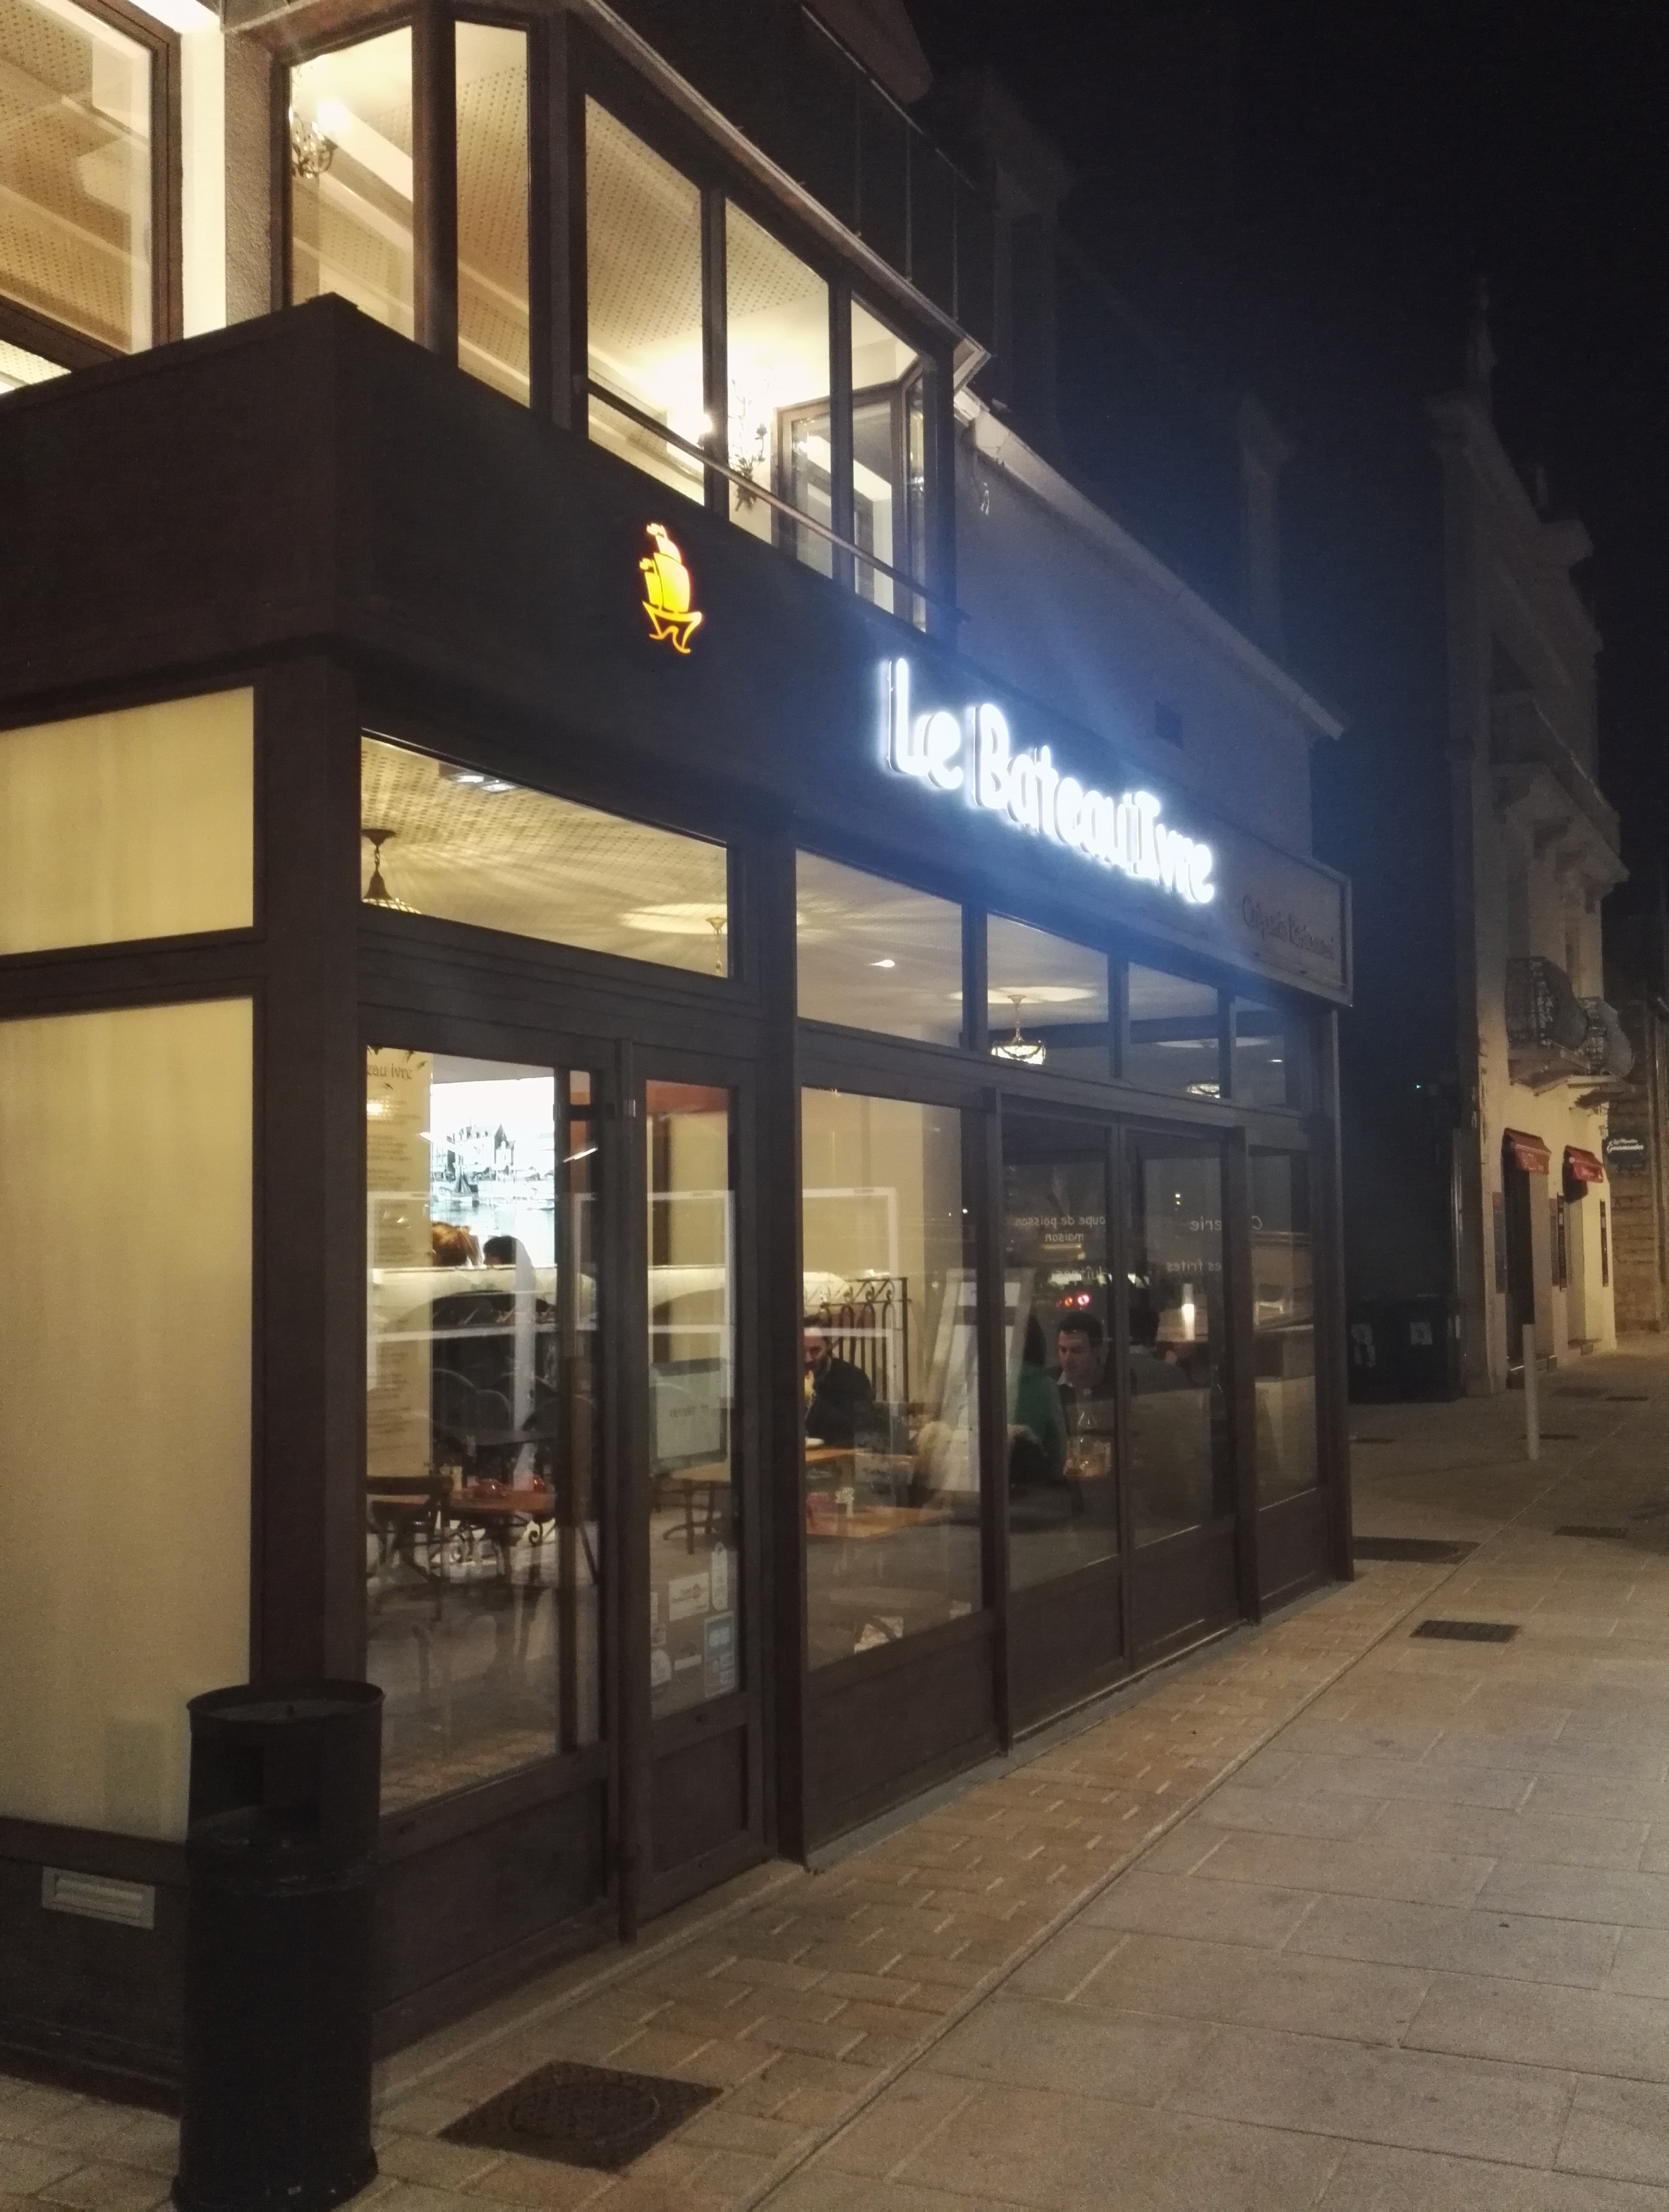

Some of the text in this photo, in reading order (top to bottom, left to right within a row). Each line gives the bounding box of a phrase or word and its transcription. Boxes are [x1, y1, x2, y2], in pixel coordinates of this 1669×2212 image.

[887, 658, 1214, 903] Le Bateau Ivre
[367, 1064, 386, 1077] eau
